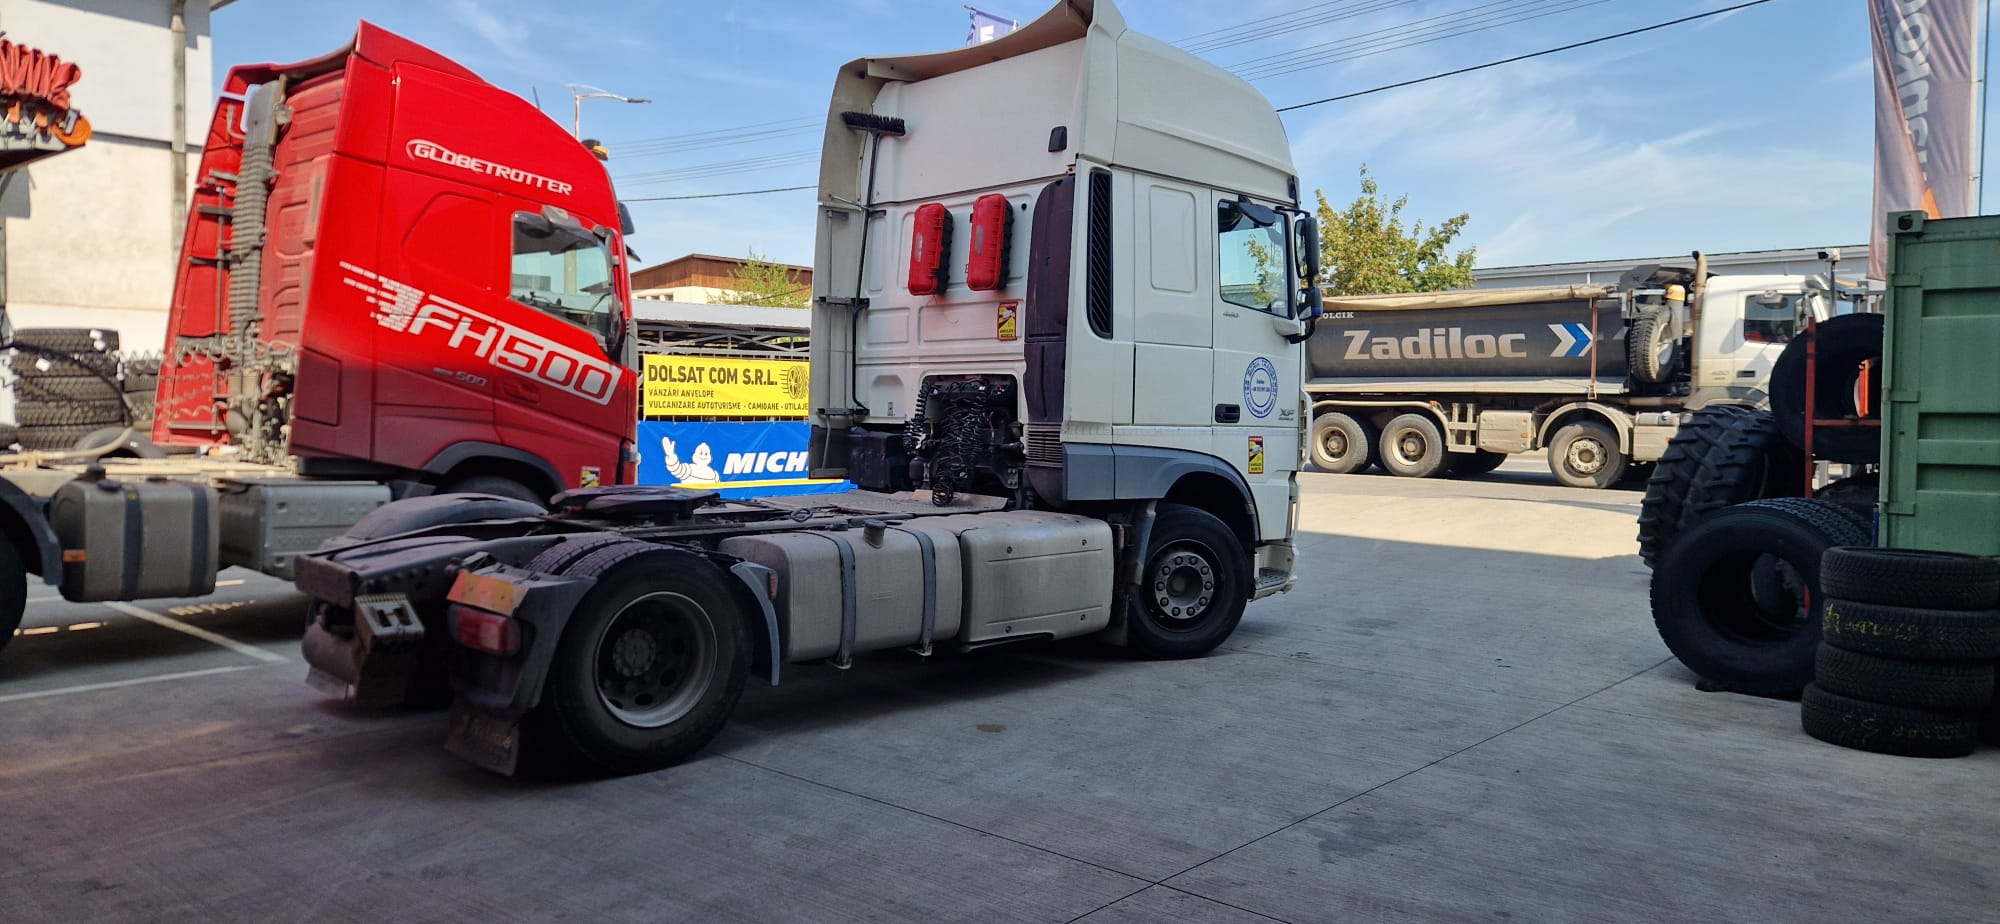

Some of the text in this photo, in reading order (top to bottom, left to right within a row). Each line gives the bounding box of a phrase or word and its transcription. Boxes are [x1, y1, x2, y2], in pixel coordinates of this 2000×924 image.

[411, 140, 573, 196] GLOBETROTTER
[1343, 327, 1527, 360] Zadiloc
[648, 364, 778, 386] DOLSAT COM S.R.L.
[681, 388, 715, 398] ANVELOPE
[648, 400, 696, 410] VULCANIZARE
[697, 400, 741, 410] AUTOTURISME
[784, 402, 809, 411] UTILAJE
[723, 451, 809, 475] MICH
